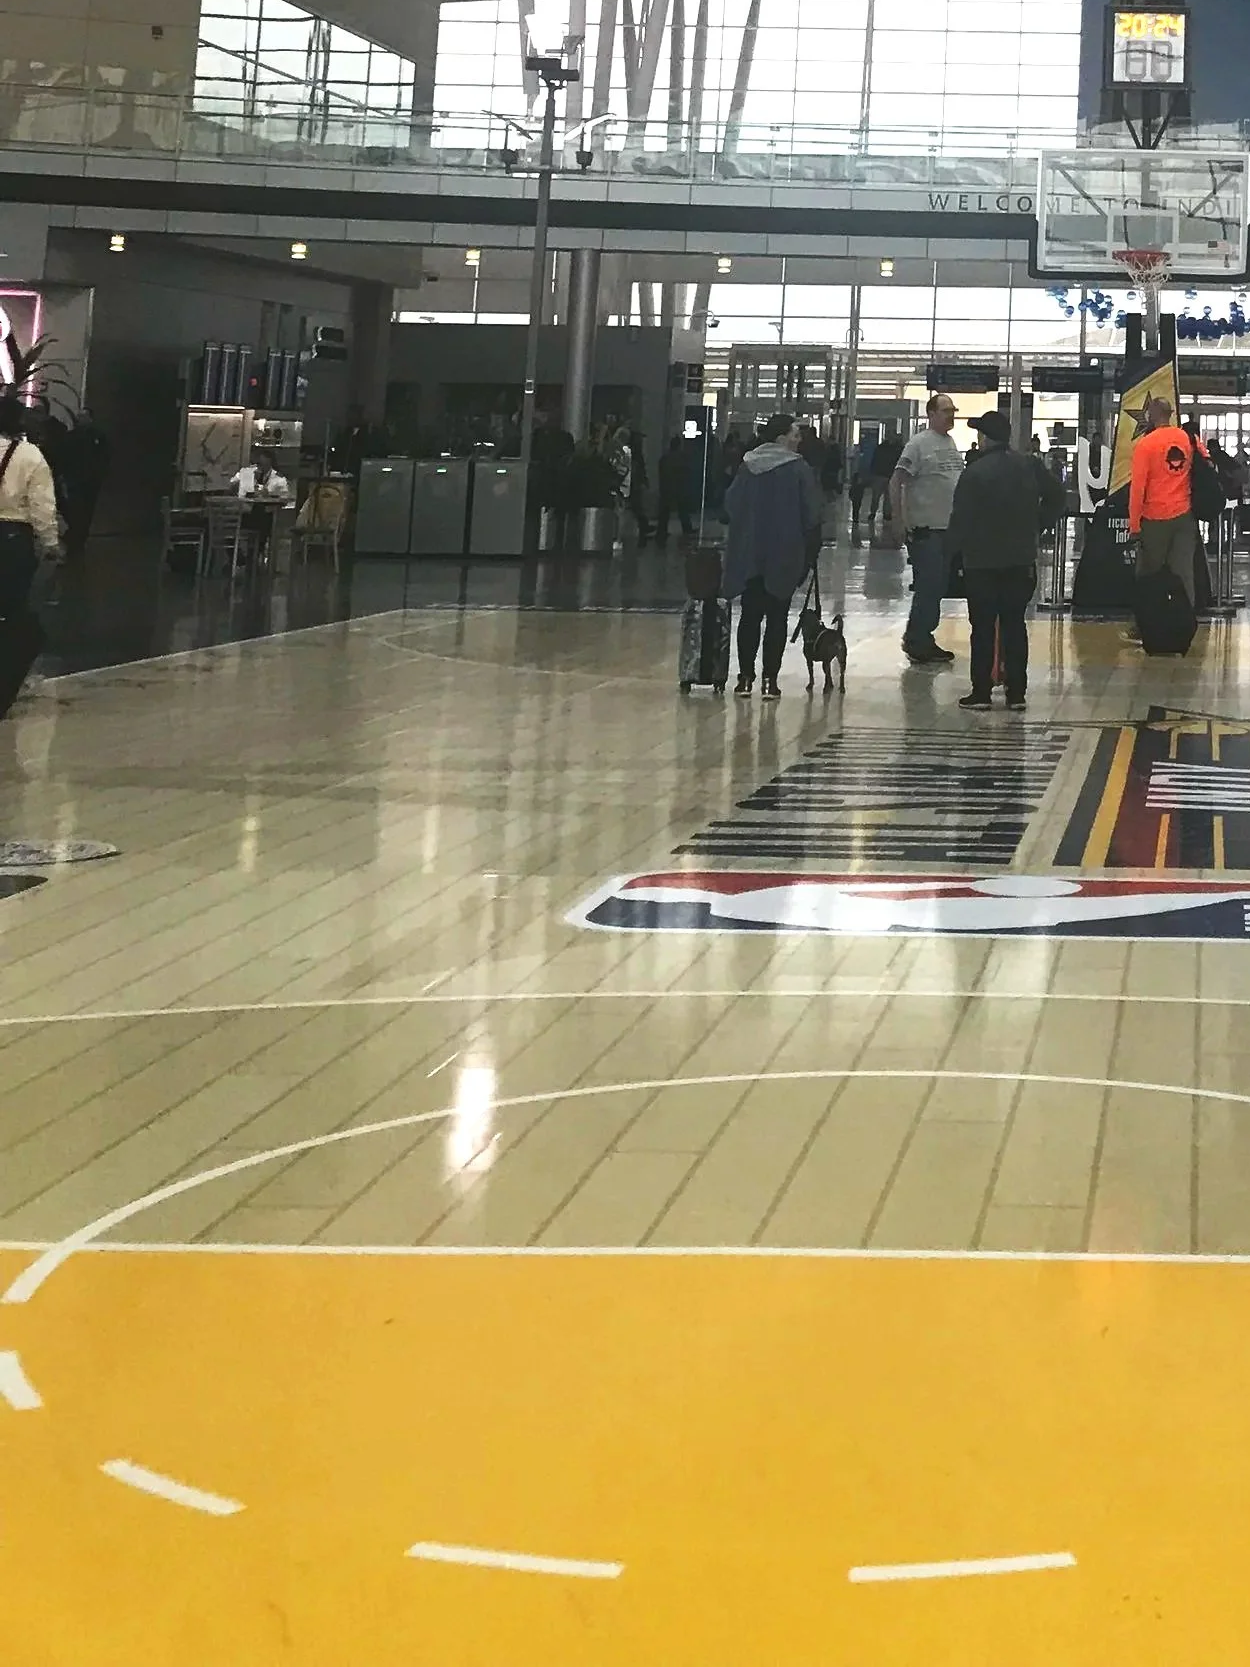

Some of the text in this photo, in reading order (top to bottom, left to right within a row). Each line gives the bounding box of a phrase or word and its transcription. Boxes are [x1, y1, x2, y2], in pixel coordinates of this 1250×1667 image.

[1117, 12, 1181, 38] 20:24
[928, 193, 1081, 214] WELCOME
[735, 762, 1062, 815] STAR
[670, 820, 1030, 865] ALL
